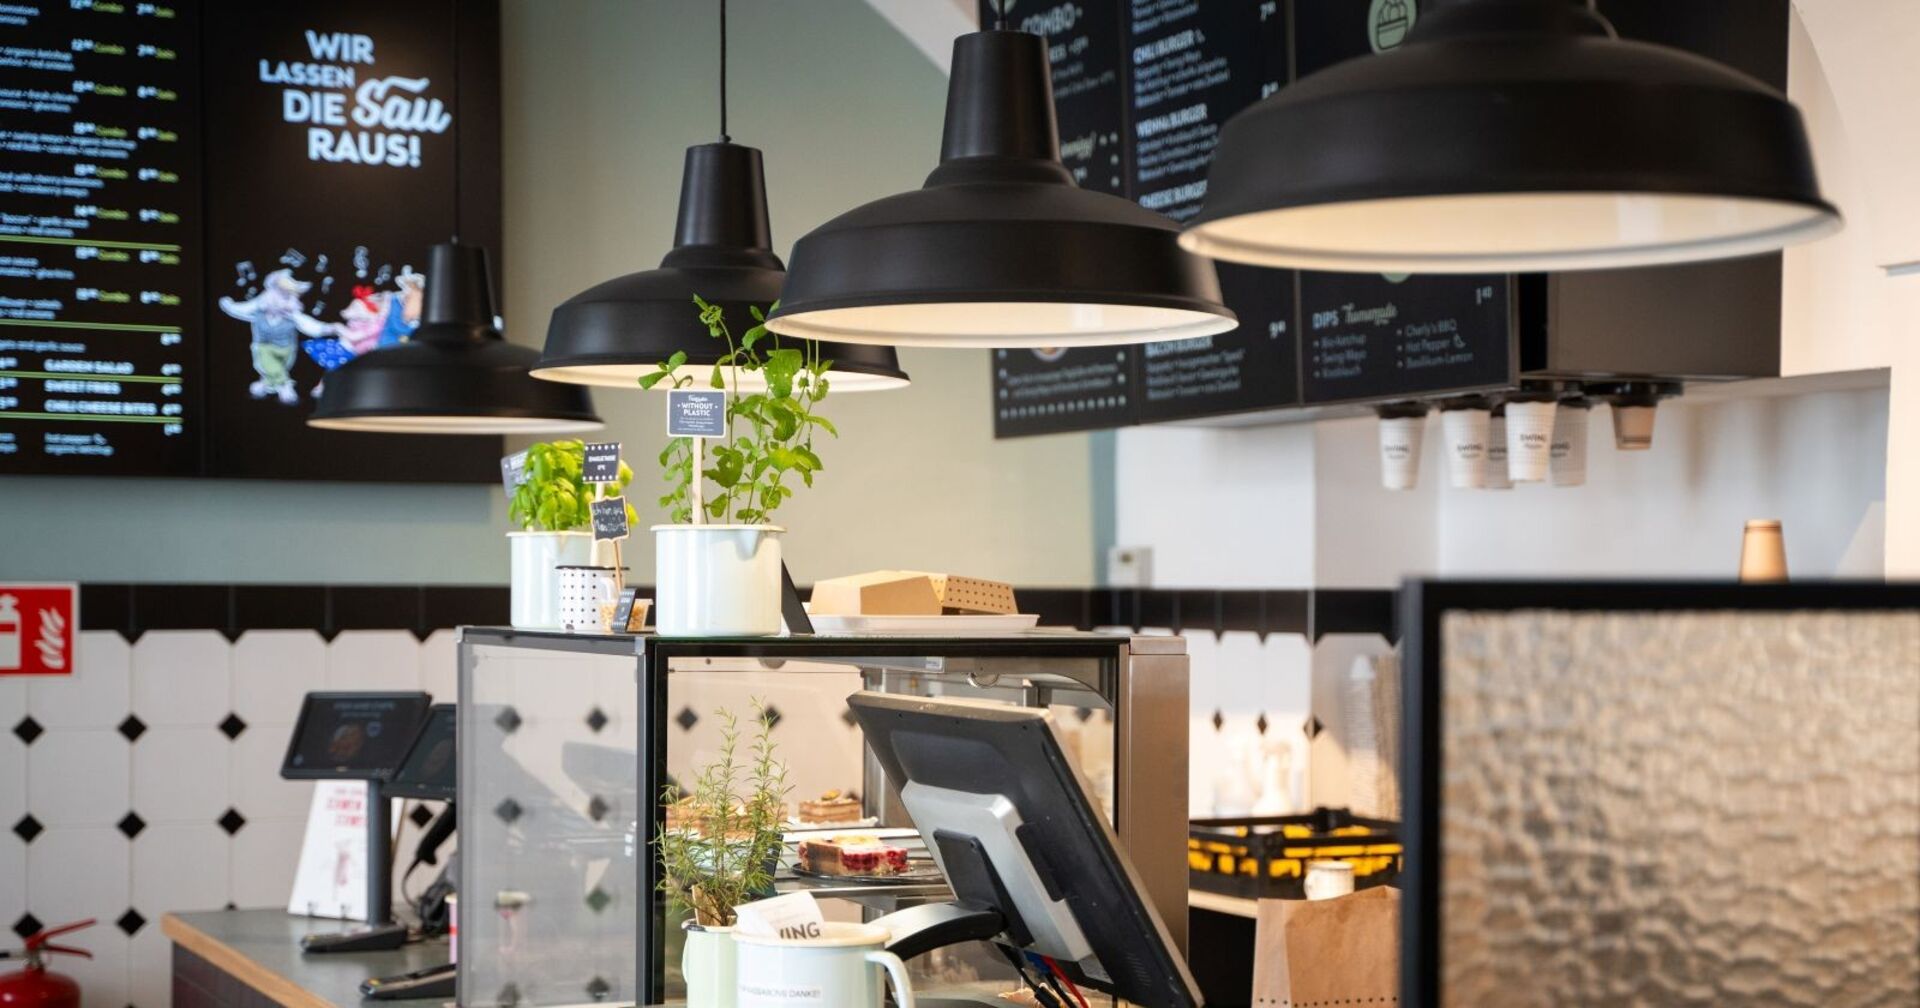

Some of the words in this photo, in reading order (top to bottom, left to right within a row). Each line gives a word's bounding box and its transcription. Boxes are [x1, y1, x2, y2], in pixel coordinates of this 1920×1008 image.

[305, 29, 374, 64] WIR
[1157, 28, 1196, 56] BURGER
[259, 59, 355, 88] LASSEN
[283, 90, 347, 126] DIE
[351, 76, 452, 134] Sau
[1170, 103, 1208, 128] BURGER
[307, 127, 421, 168] RAUS!
[1312, 309, 1340, 330] DIPS
[44, 358, 93, 372] GARDEN
[94, 360, 135, 376] SALAD
[681, 402, 714, 410] WITHOUT
[683, 409, 711, 417] PLASTIC
